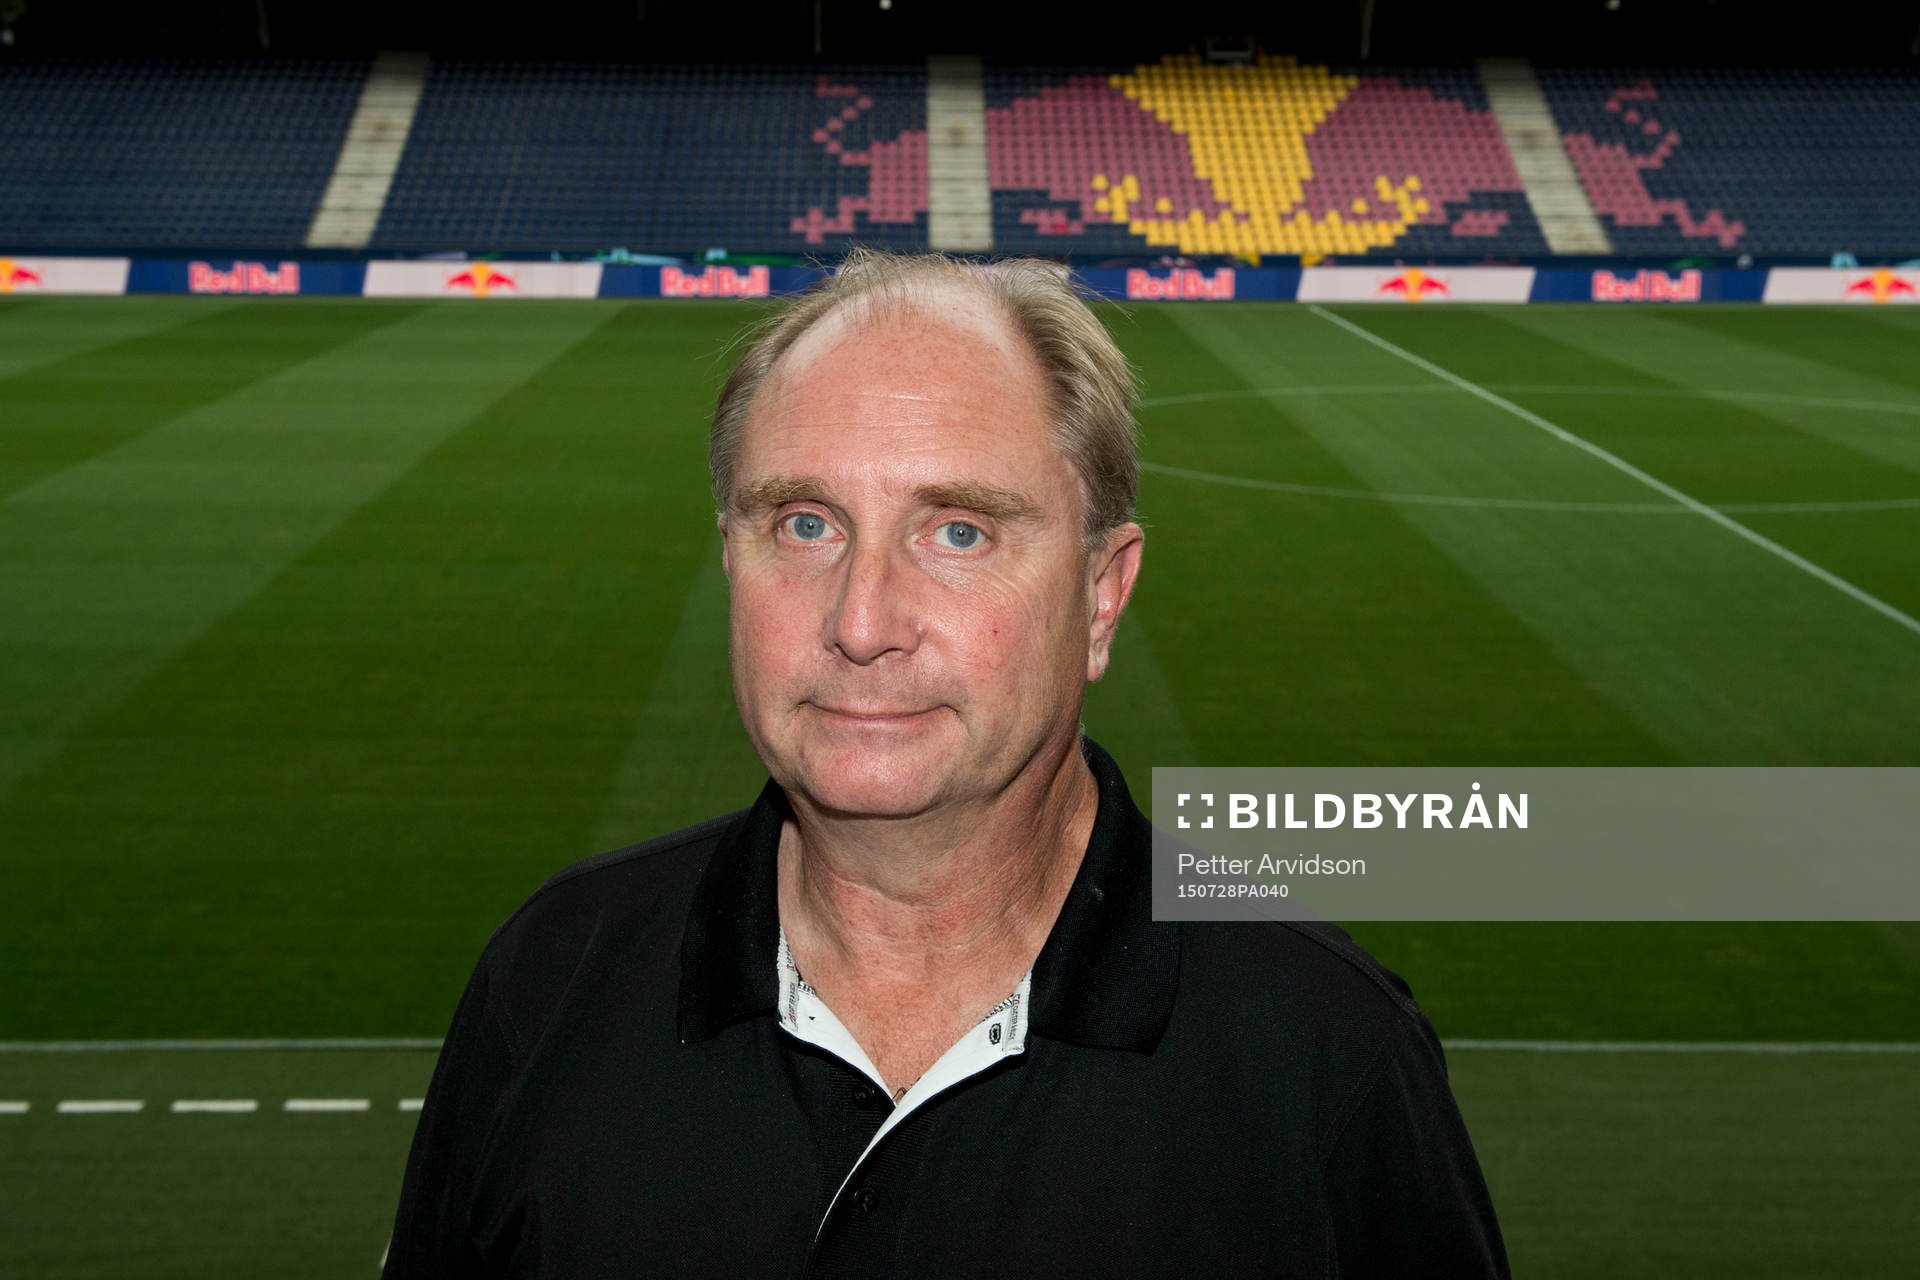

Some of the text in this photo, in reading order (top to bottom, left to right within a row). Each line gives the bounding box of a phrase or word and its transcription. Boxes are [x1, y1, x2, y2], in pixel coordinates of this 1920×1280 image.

[190, 261, 299, 293] Red Bull
[662, 265, 768, 297] Red Bull
[1127, 268, 1235, 299] Red Bull
[1593, 269, 1700, 301] Red Bull
